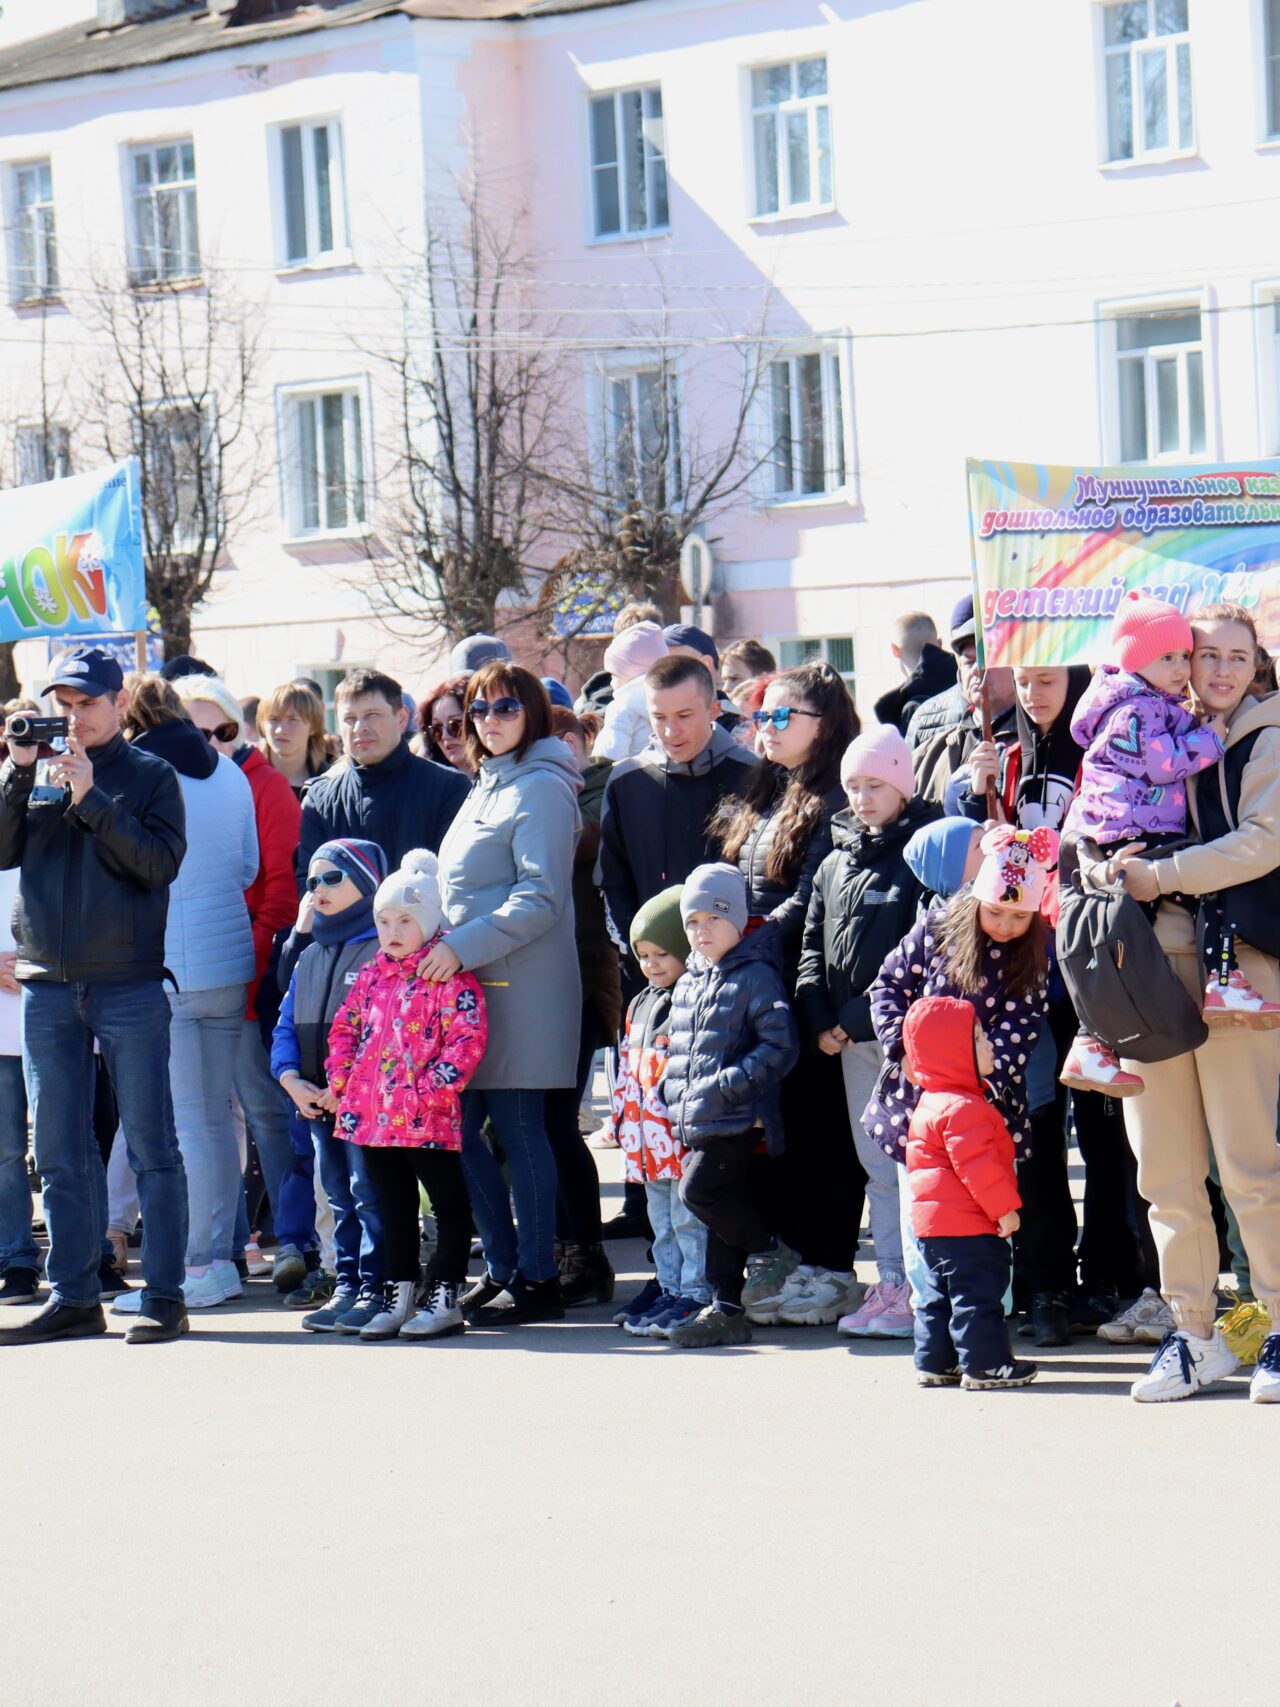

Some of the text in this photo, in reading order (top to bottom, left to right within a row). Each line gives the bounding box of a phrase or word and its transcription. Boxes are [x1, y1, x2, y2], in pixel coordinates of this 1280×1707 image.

[1074, 474, 1242, 505] Муниципальное
[980, 506, 1117, 538] дошкольное
[984, 577, 1126, 628] детский
